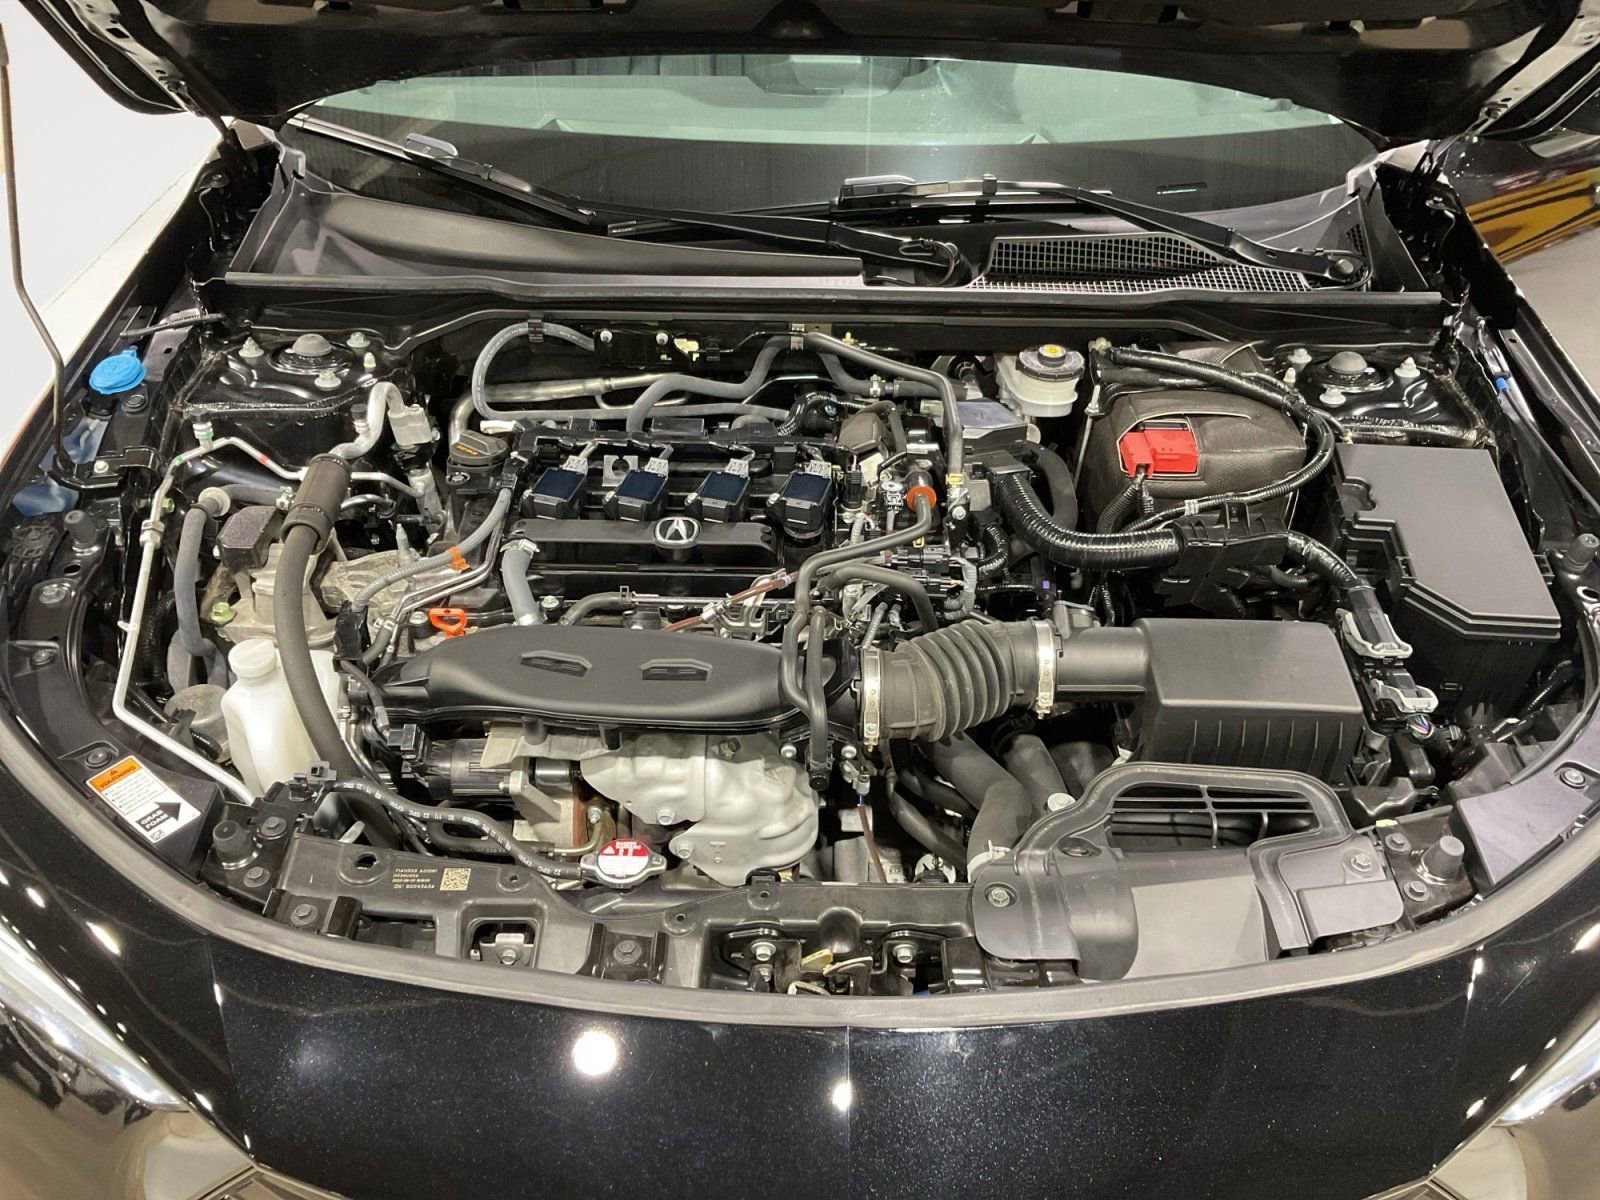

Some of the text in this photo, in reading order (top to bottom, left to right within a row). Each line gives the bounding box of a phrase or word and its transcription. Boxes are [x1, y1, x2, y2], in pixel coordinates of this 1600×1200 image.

[98, 765, 137, 788] WARNING
[140, 809, 164, 825] GRAB
[145, 814, 169, 829] FOAM
